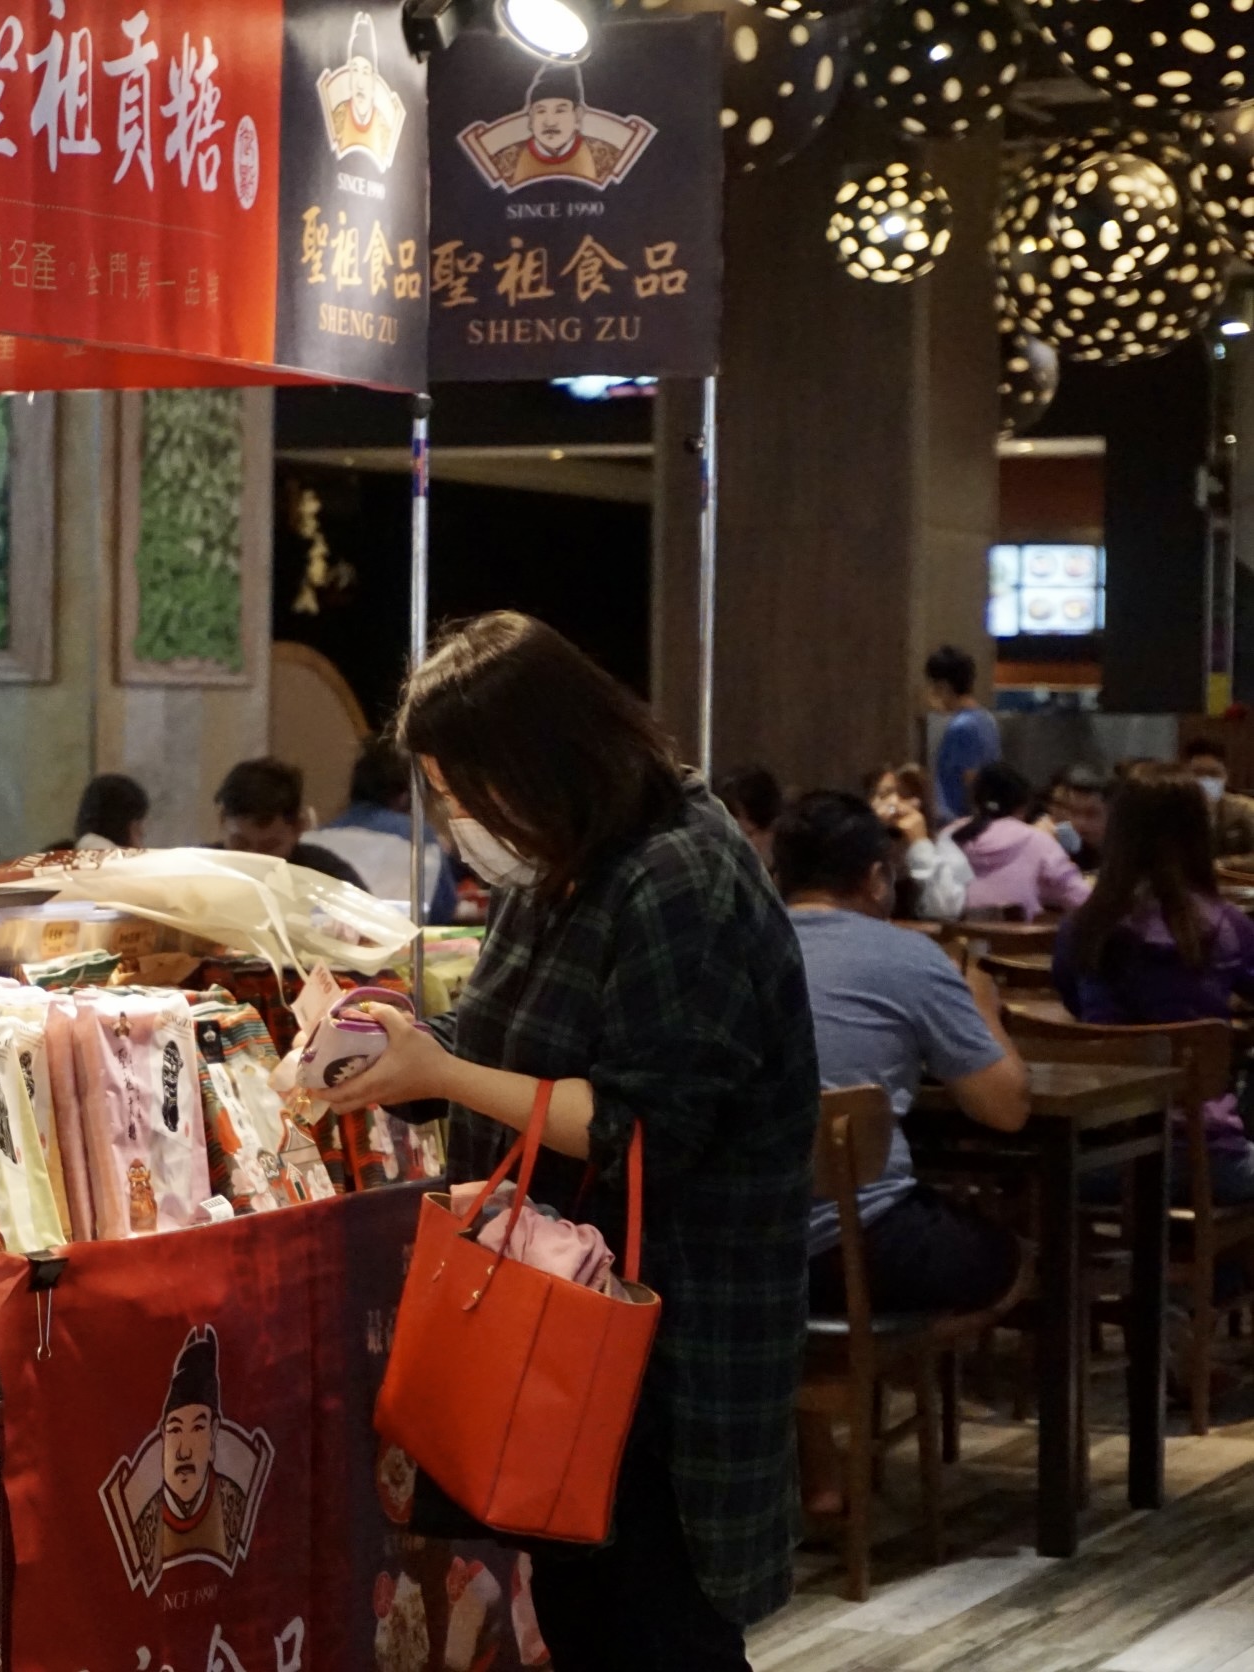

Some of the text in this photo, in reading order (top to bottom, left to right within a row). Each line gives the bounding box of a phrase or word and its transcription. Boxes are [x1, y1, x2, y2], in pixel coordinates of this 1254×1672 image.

[338, 172, 366, 196] SINCE
[506, 202, 604, 220] SINCE 1990
[300, 205, 422, 300] 聖祖食品
[430, 235, 689, 308] 聖祖食品
[319, 304, 399, 345] SHENG ZU
[468, 317, 642, 345] SHENG ZU
